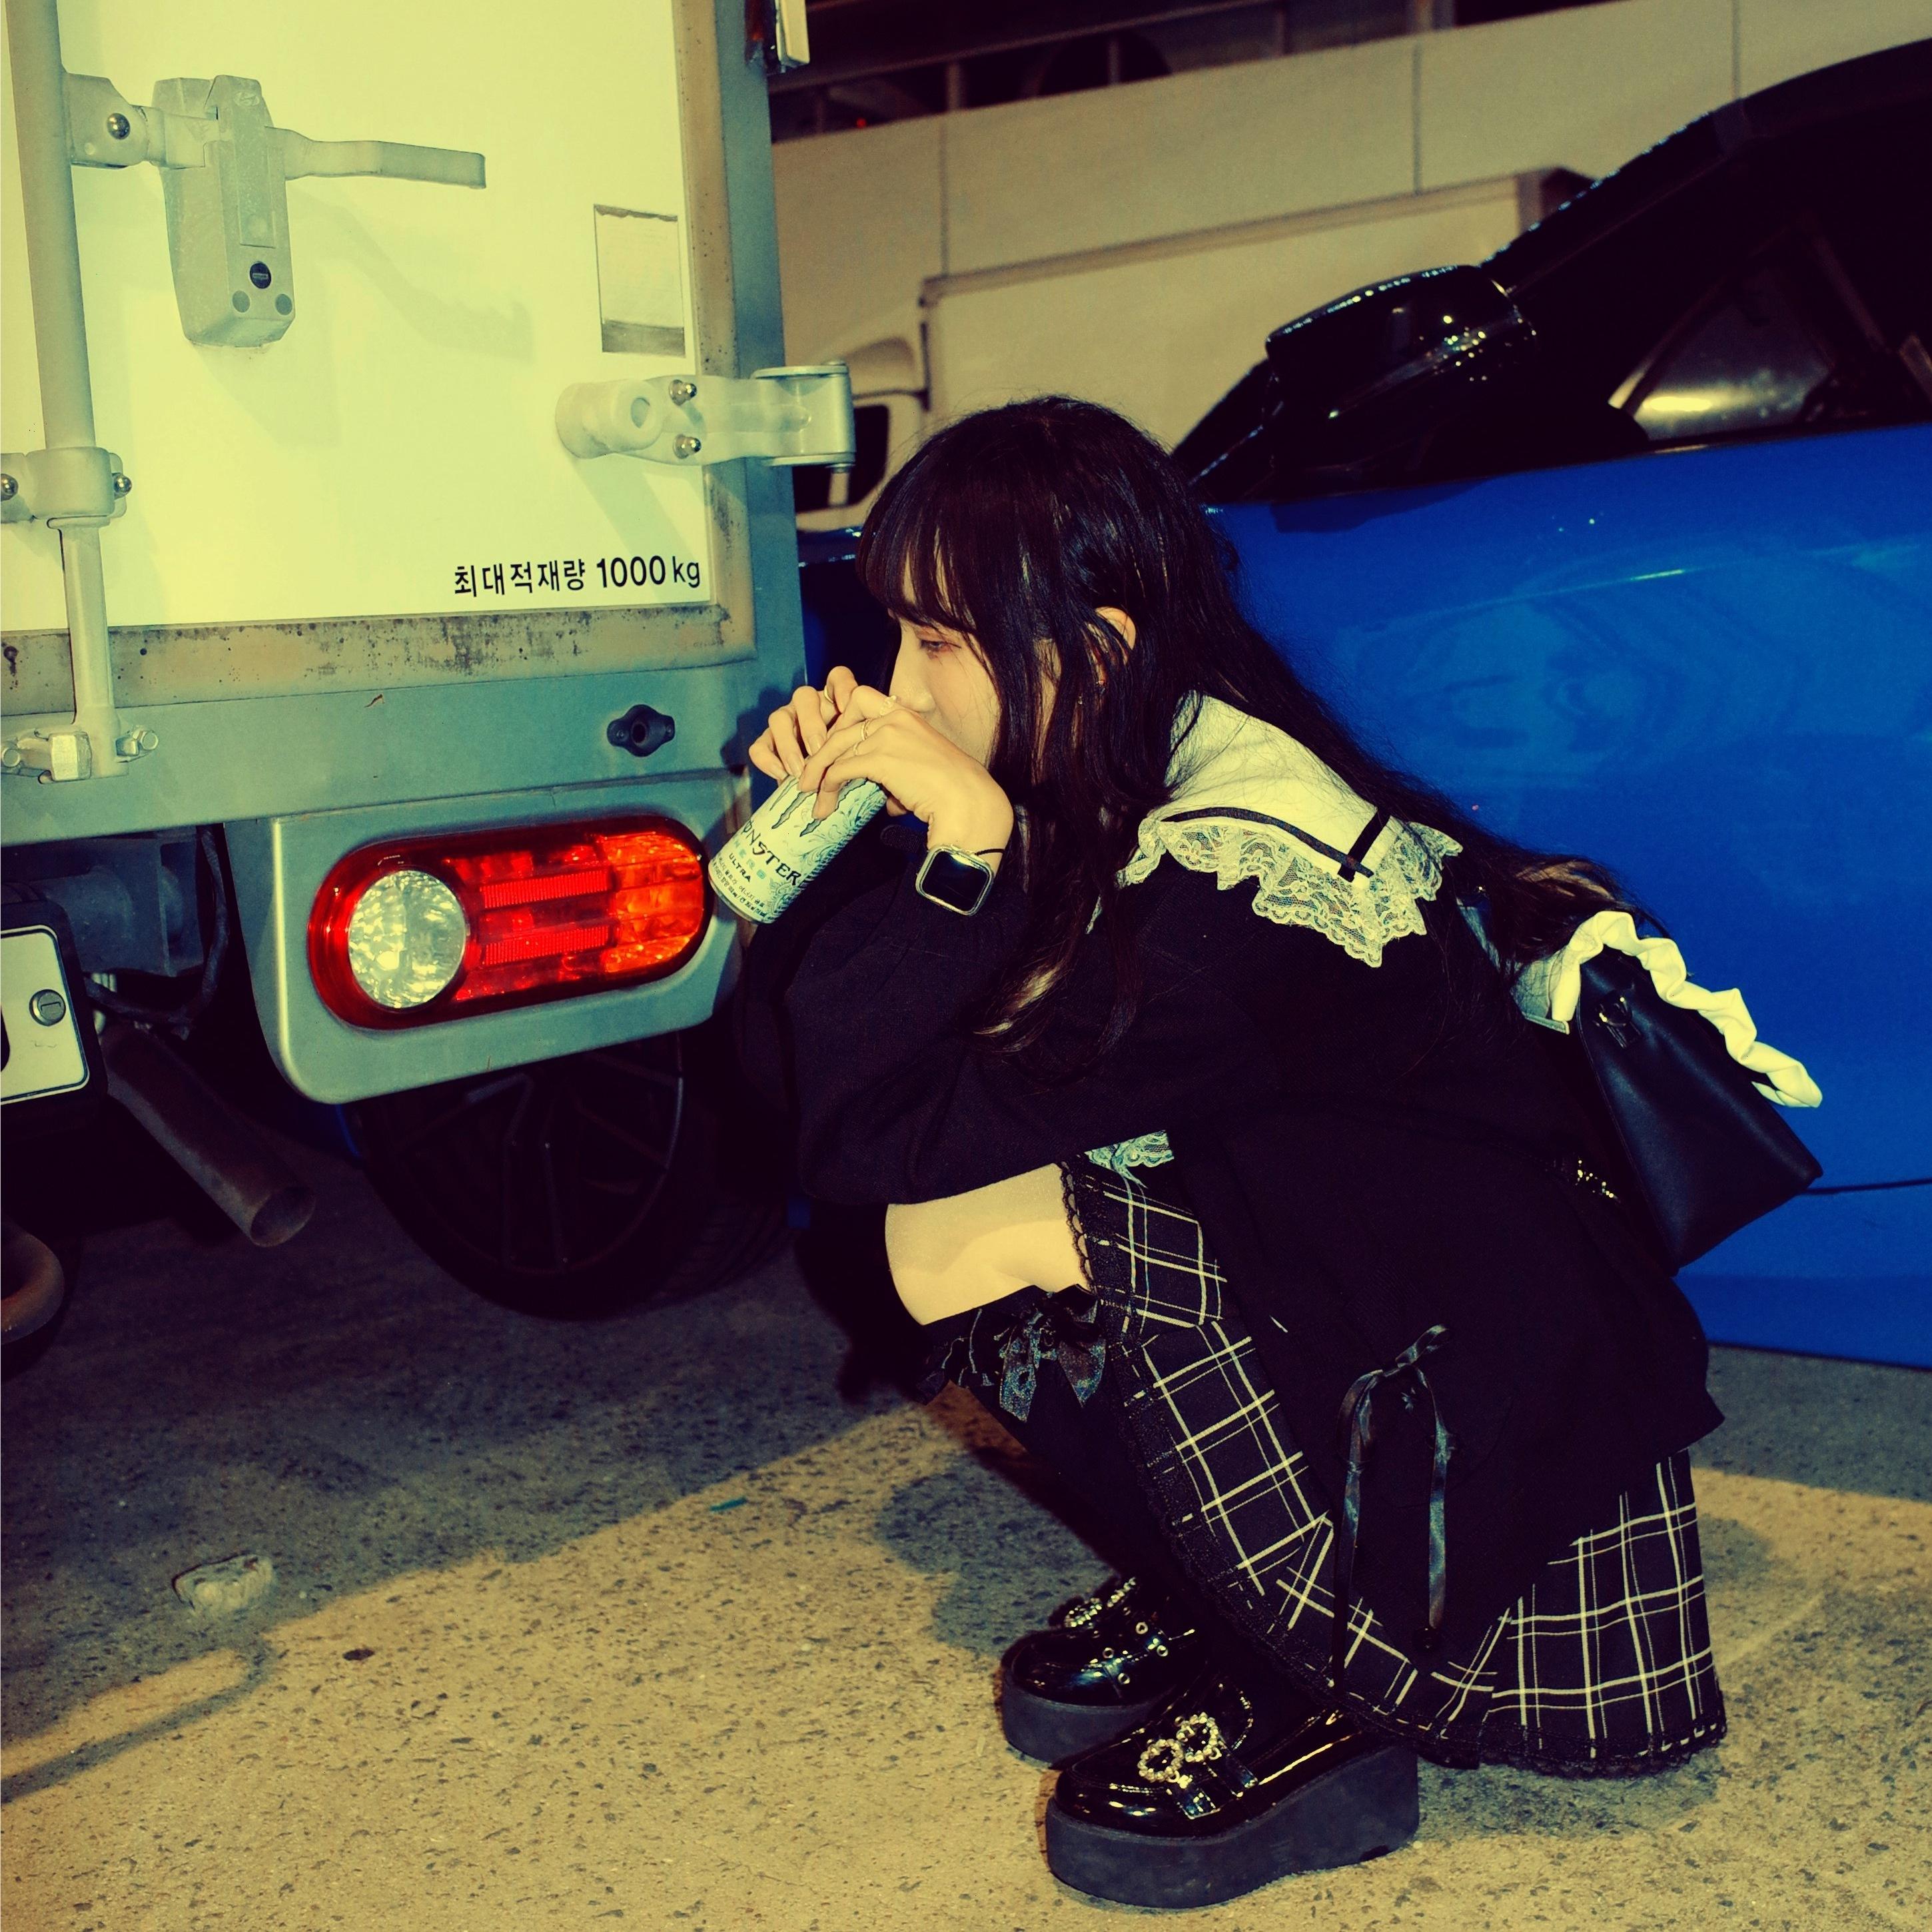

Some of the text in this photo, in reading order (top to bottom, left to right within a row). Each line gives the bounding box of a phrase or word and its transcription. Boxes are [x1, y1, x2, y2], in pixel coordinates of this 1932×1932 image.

[454, 555, 700, 597] 최대적재량 1000 kg
[729, 853, 751, 883] ULTRA
[741, 820, 801, 886] ONSTER
